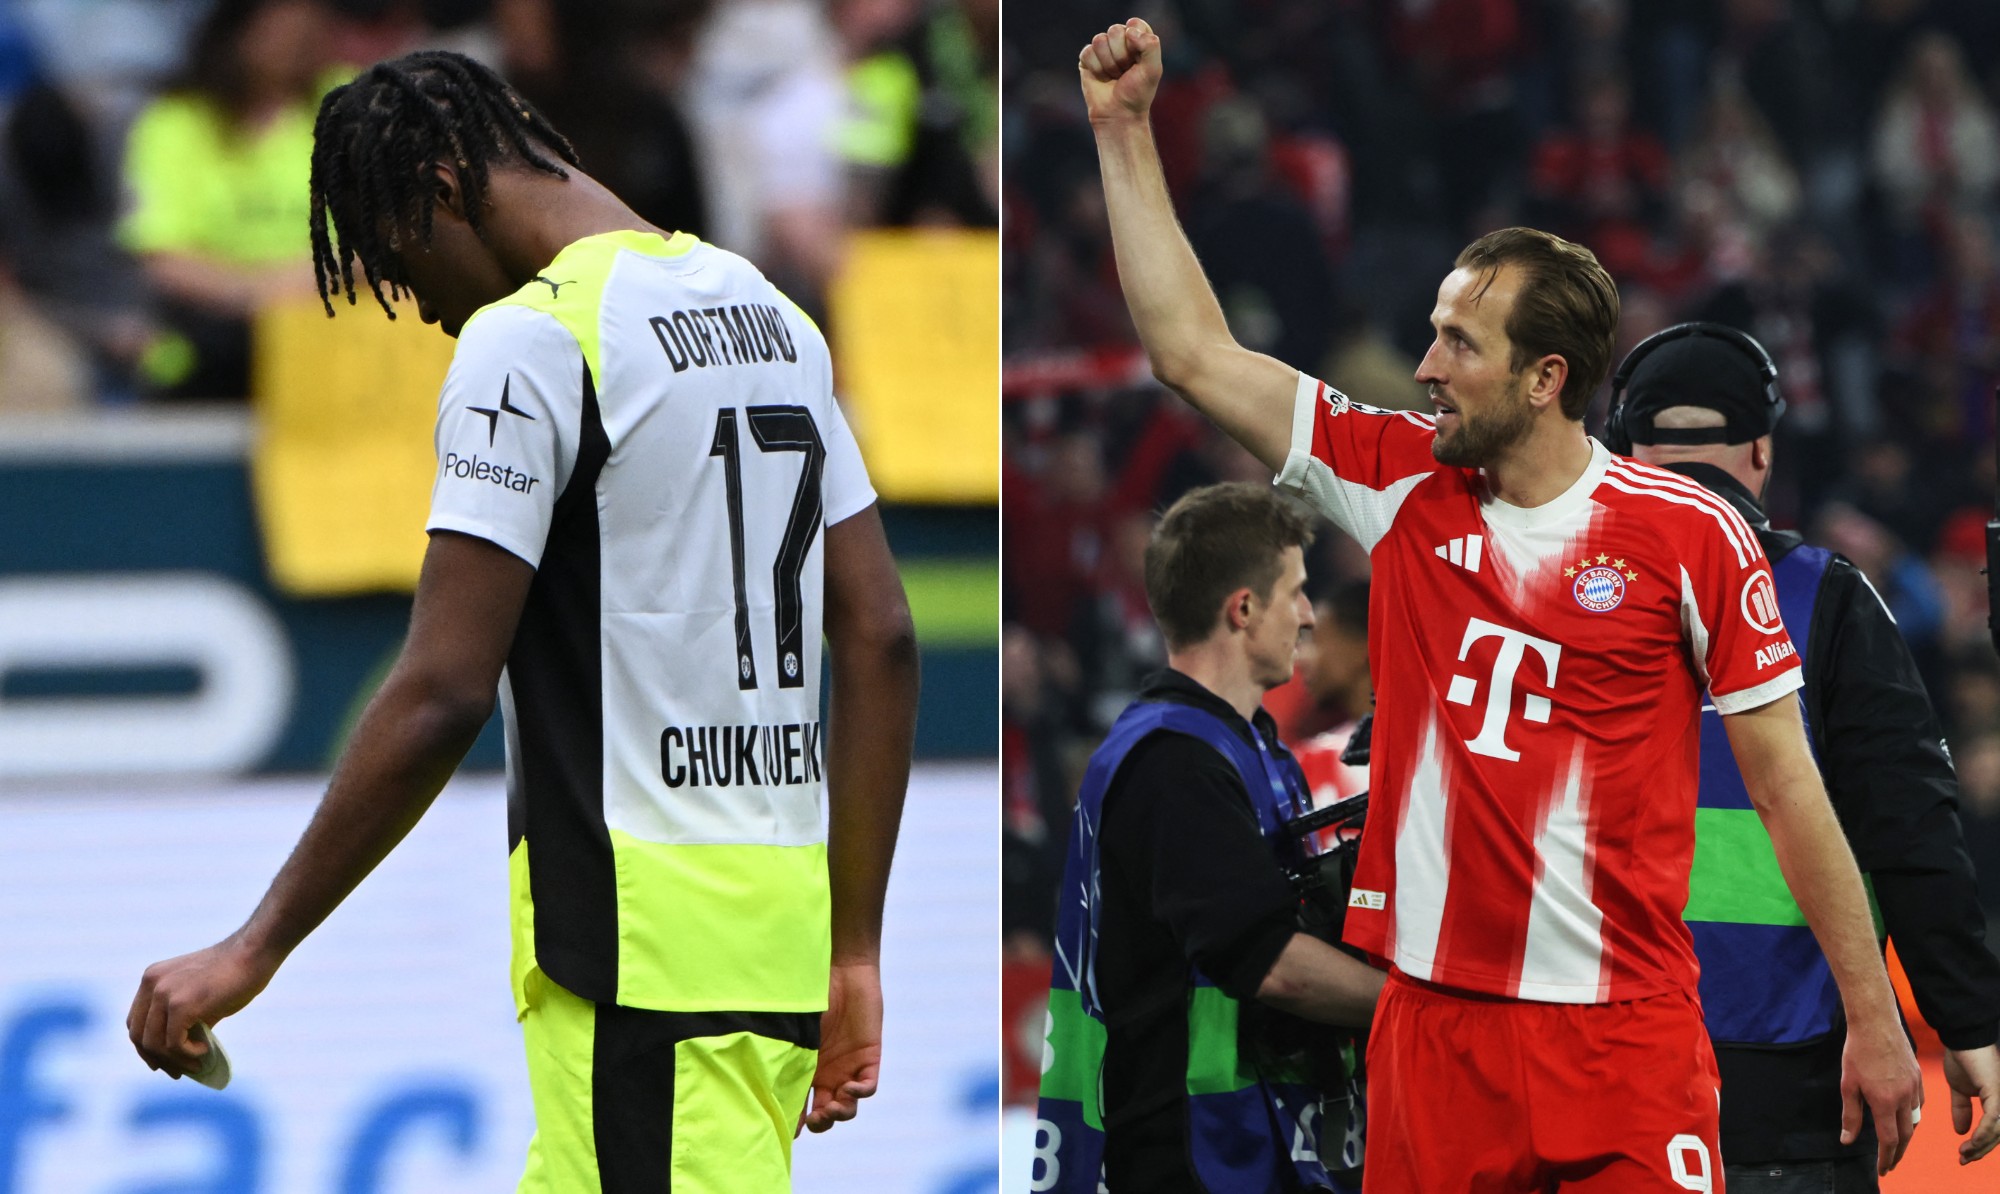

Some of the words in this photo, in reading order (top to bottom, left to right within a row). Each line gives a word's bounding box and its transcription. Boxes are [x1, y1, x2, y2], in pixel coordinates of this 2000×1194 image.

[648, 303, 798, 373] DORTMUND
[444, 452, 540, 494] Polestar
[709, 404, 827, 691] 17
[1578, 576, 1590, 587] FC
[1590, 571, 1621, 588] BAYERN
[1666, 1133, 1713, 1194] 9
